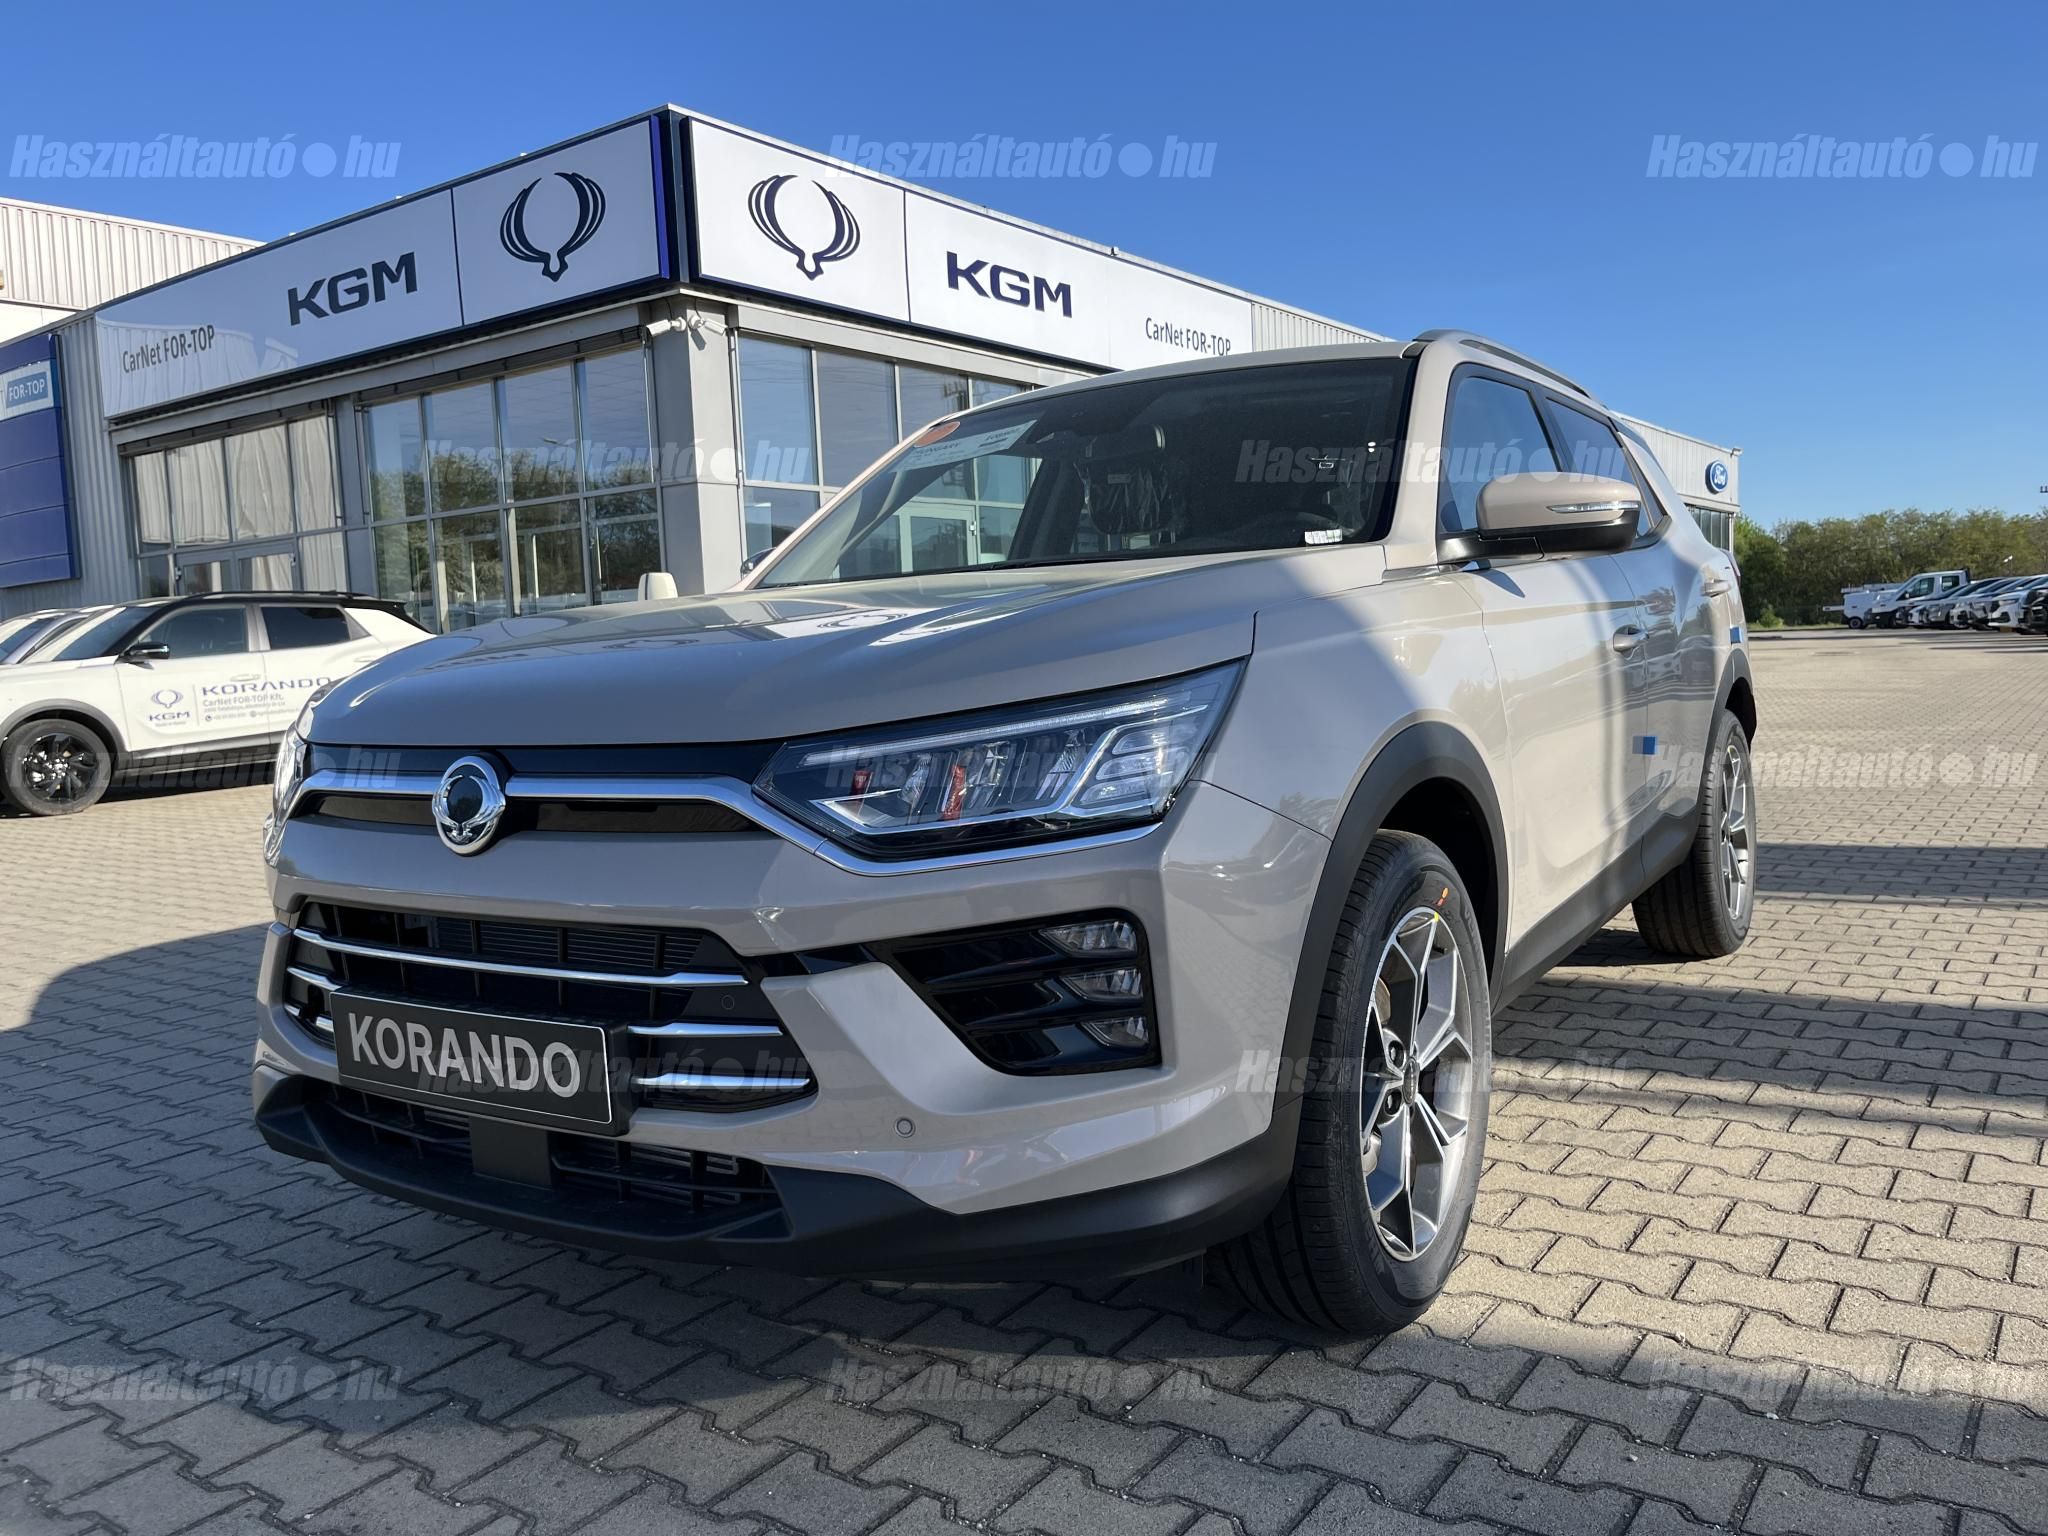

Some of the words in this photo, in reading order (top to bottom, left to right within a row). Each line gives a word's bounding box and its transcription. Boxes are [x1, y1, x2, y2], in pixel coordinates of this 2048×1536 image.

[287, 251, 418, 326] KGM
[946, 250, 1073, 319] KGM
[122, 343, 162, 374] CarNet
[163, 324, 215, 362] FOR-TOP
[1145, 317, 1184, 348] CarNet
[1186, 328, 1232, 357] FOR-TOP
[8, 378, 46, 401] FOR-TOP
[202, 676, 331, 696] KORANDO
[149, 711, 190, 721] KGM
[348, 1012, 581, 1098] KORANDO
